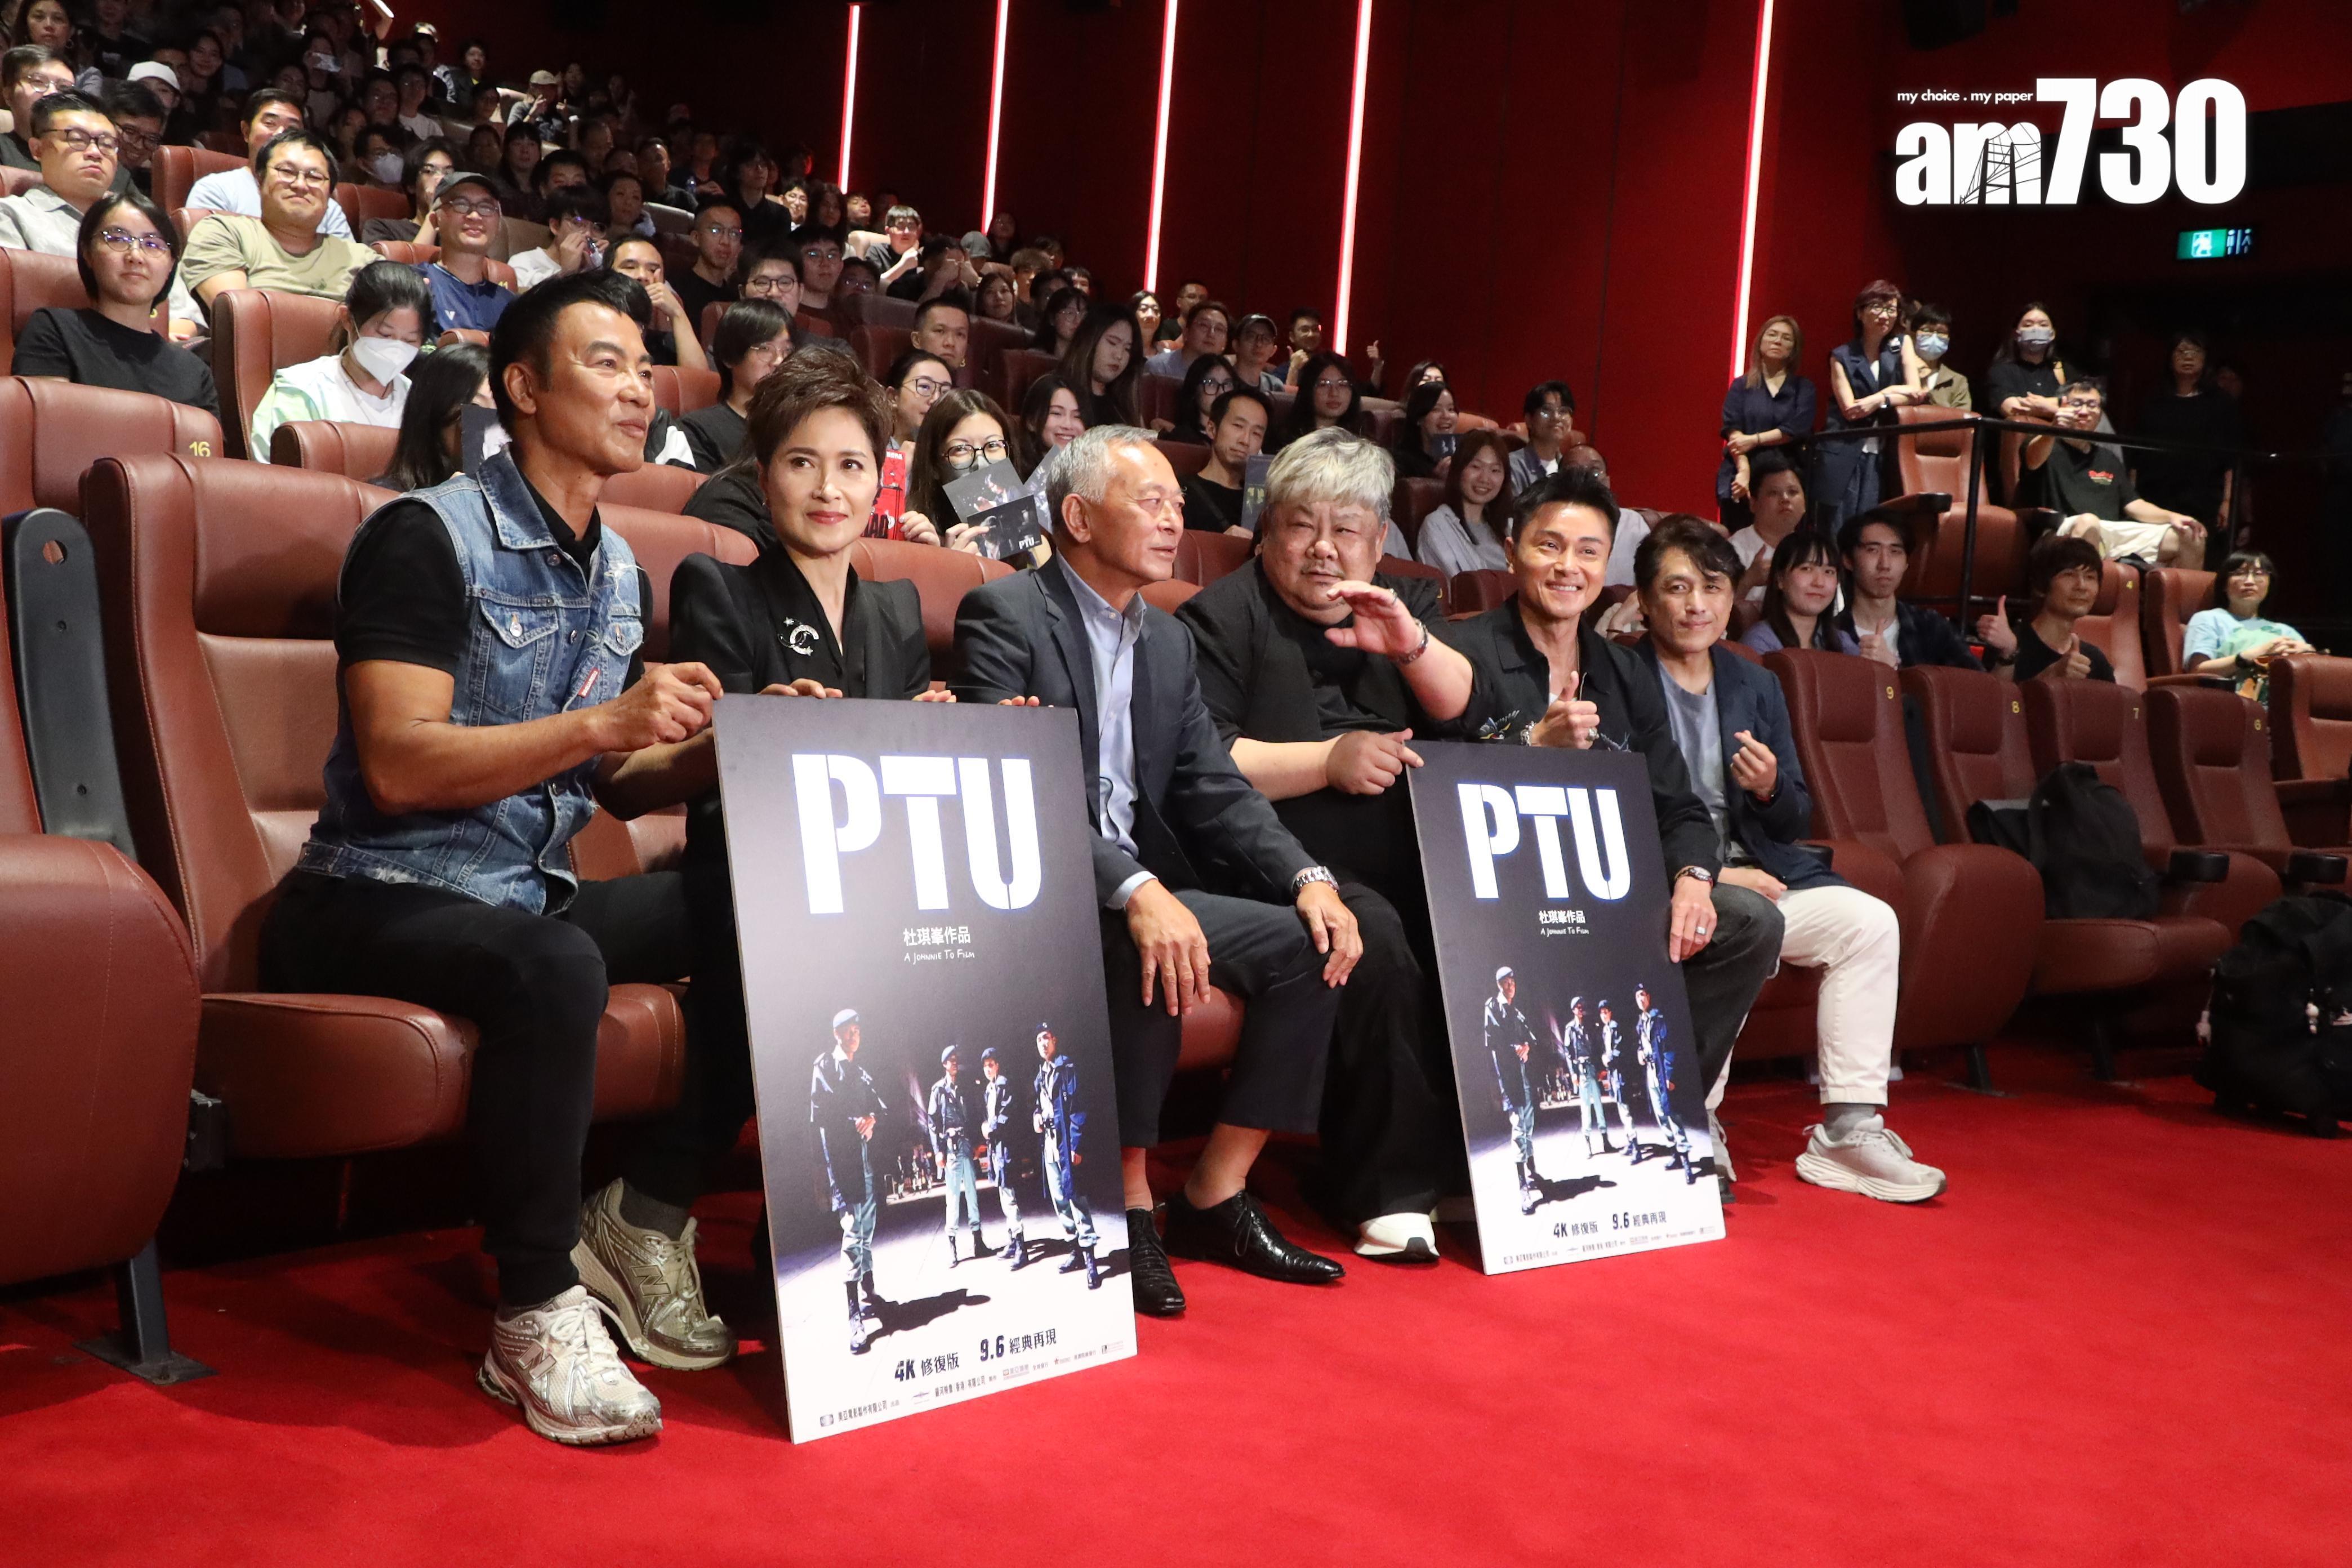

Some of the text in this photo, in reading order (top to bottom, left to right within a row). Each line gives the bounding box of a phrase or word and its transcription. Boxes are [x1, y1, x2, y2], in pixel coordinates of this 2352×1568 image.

[189, 441, 211, 457] 16
[1018, 534, 1035, 550] PTU
[2126, 580, 2133, 589] 4
[1886, 686, 1894, 700] 9
[2012, 701, 2020, 714] 8
[2133, 707, 2140, 719] 7
[2254, 719, 2262, 730] 6
[791, 754, 1042, 914] PTU
[1457, 783, 1631, 899] PTU
[903, 926, 971, 947] 杜琪峯作品
[1540, 927, 1546, 936] A
[904, 952, 911, 963] A
[1553, 1211, 1667, 1238] 4K 修復版 9.6 經典再現
[894, 1328, 1057, 1382] 4K 修復版 9.6 經典再現
